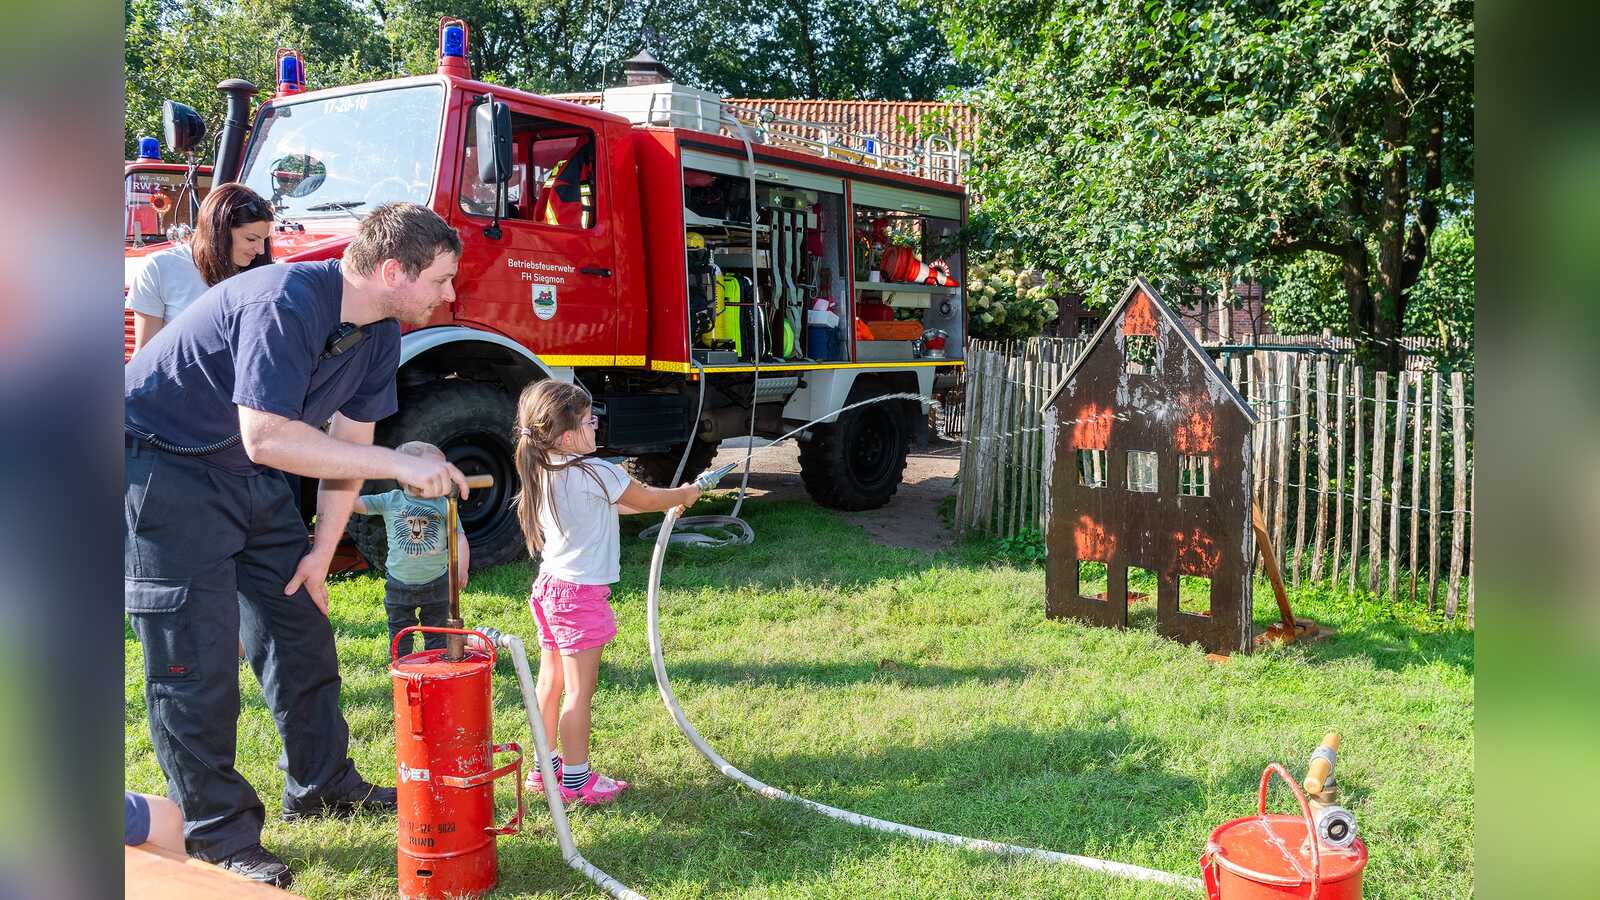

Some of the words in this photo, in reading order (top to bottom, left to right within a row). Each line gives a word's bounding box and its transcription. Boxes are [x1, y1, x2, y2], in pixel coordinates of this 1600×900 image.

[133, 182, 151, 190] RW
[507, 258, 576, 273] Betriebsfeuerwehr
[521, 271, 532, 281] FH
[533, 273, 565, 285] Siegmon
